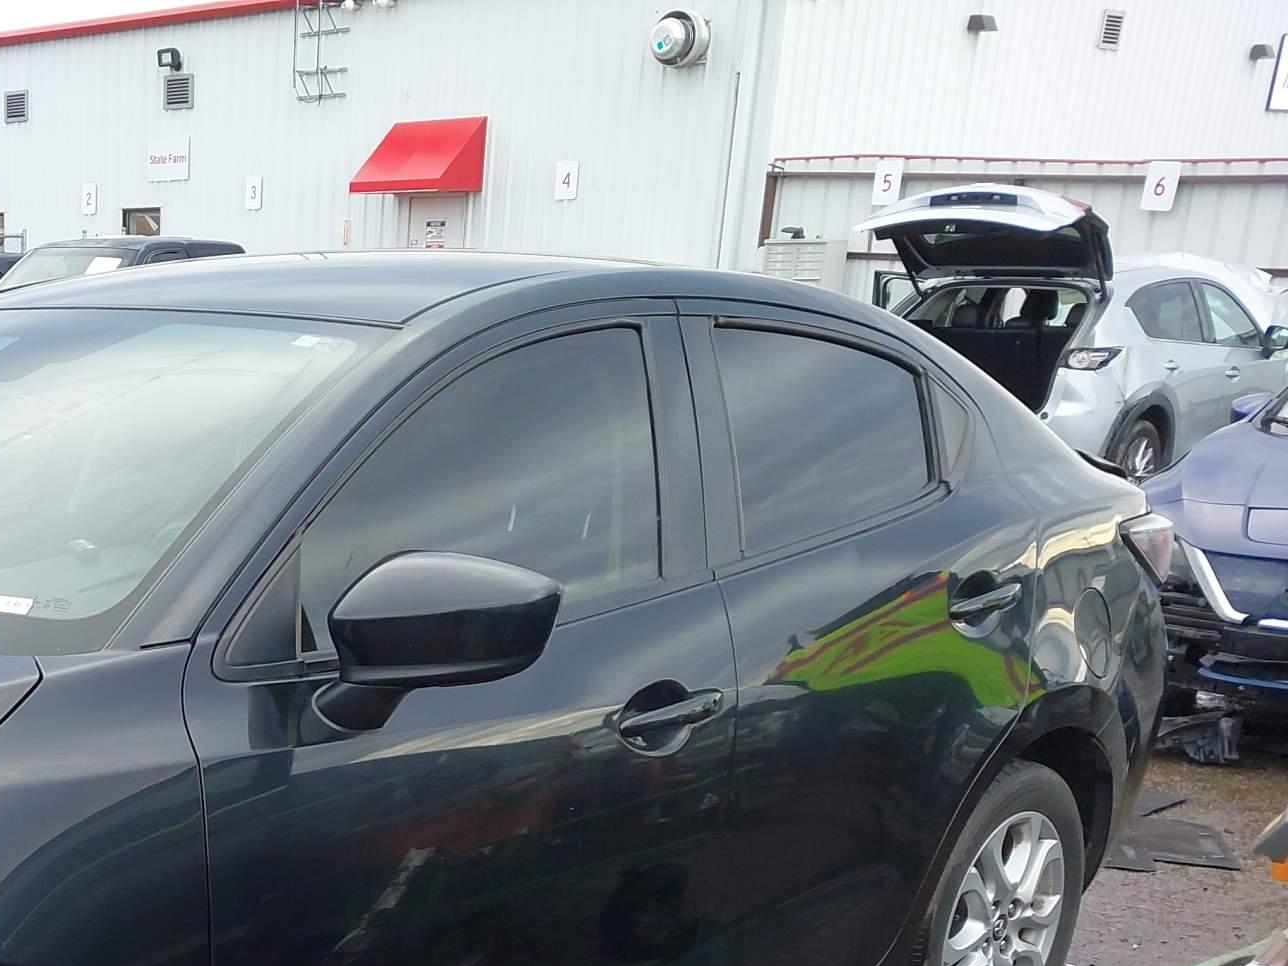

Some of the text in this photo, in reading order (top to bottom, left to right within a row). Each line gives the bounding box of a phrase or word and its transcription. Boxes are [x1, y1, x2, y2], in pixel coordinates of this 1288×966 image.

[149, 153, 187, 165] State Farm
[562, 172, 571, 188] 4
[881, 173, 892, 193] 5
[1153, 176, 1166, 196] 6
[85, 192, 92, 206] 2
[250, 186, 257, 200] 3
